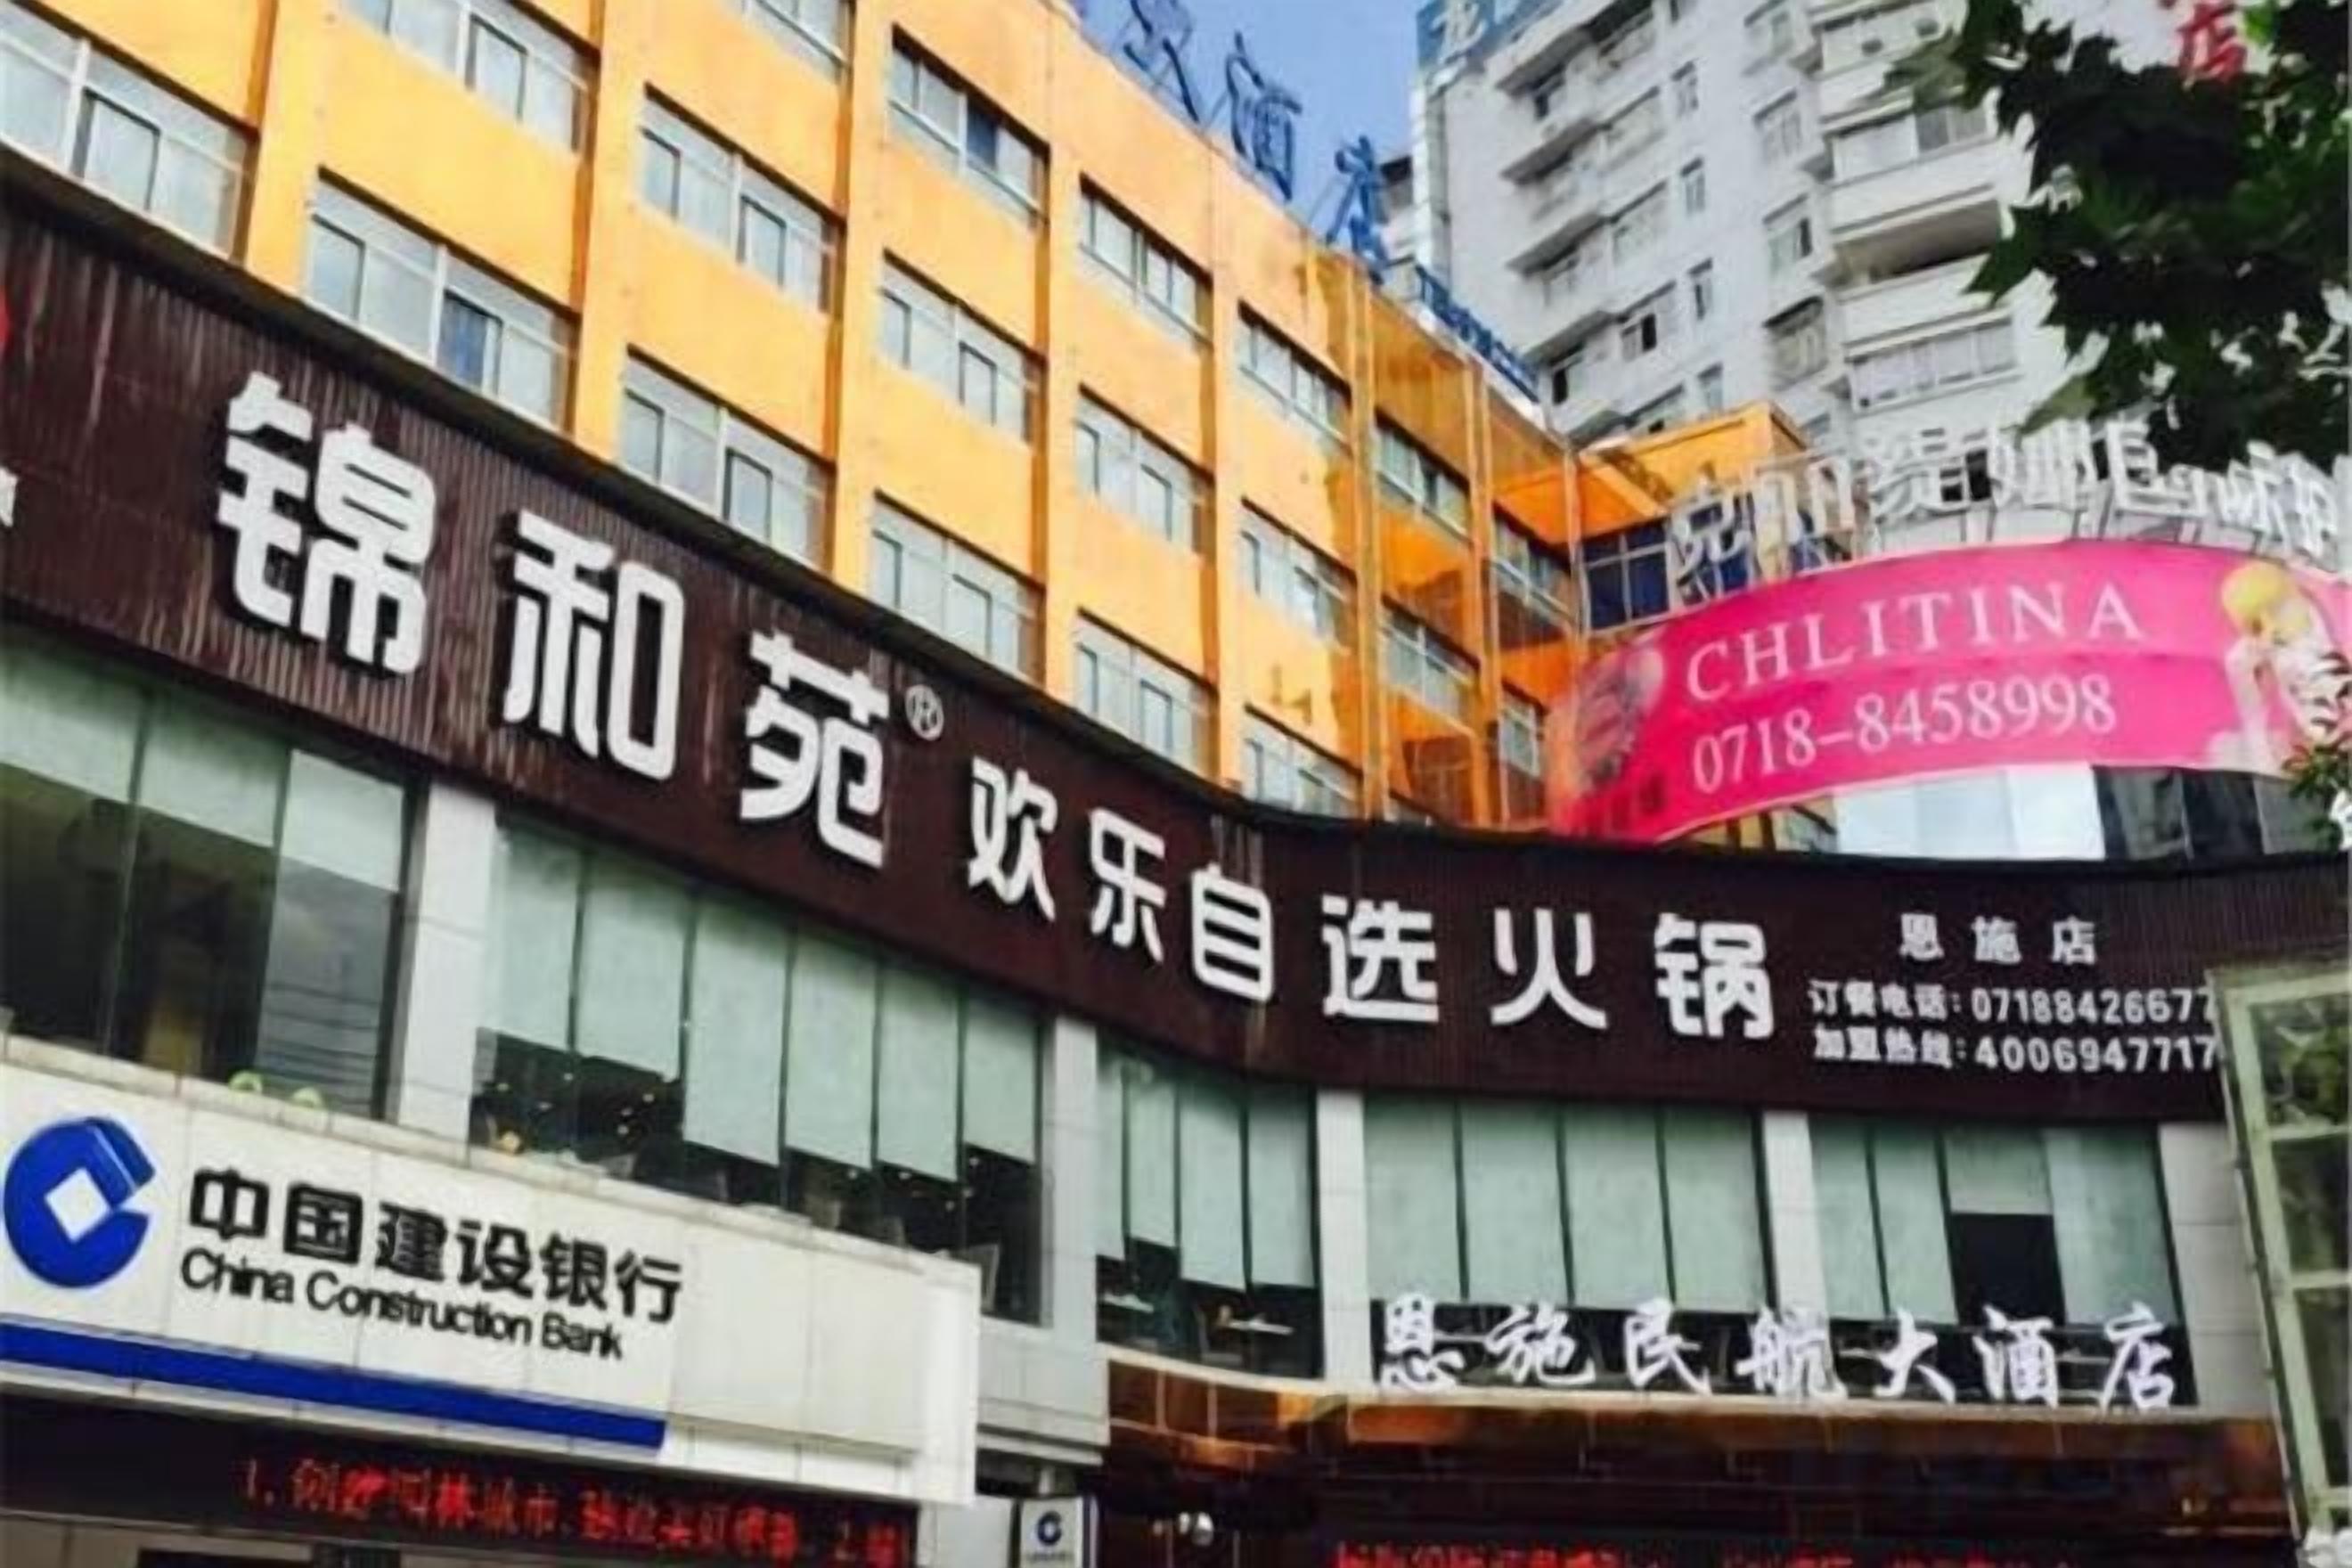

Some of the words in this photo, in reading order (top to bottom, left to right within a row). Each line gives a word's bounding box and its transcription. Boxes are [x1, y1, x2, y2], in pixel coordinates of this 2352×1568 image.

[1686, 581, 2144, 703] CHLITINA
[216, 372, 891, 870] 锦和苑
[967, 755, 1775, 1041] 欢乐自选火锅
[1692, 673, 2118, 796] 0718-8458998
[1899, 911, 2098, 966] 恩施店
[181, 1246, 295, 1306] China
[306, 1269, 533, 1346] Construction
[541, 1311, 624, 1361] Bank
[189, 1166, 684, 1324] 中国建设银行
[1378, 1292, 2176, 1413] 恩施民航大酒店
